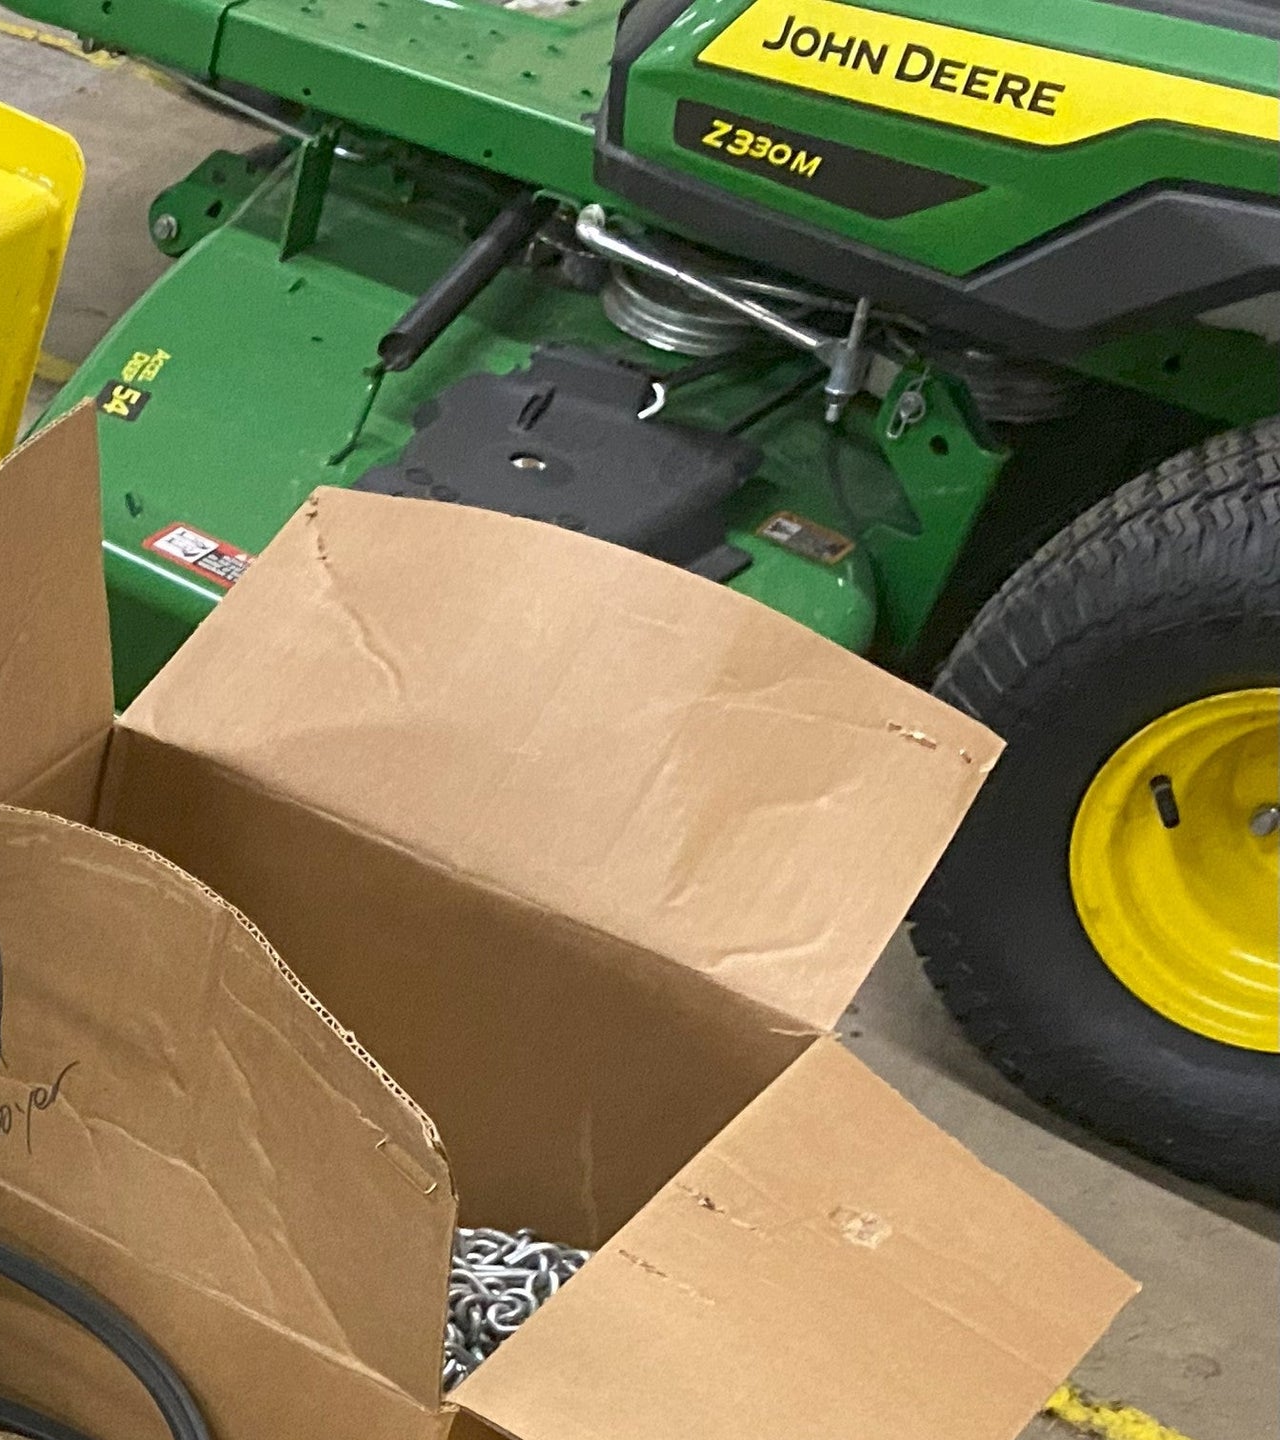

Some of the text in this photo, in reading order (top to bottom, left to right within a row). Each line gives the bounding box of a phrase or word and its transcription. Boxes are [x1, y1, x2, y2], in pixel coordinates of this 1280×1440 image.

[762, 15, 1066, 117] JOHN DEERE
[701, 118, 824, 179] Z330M
[103, 385, 141, 416] 54
